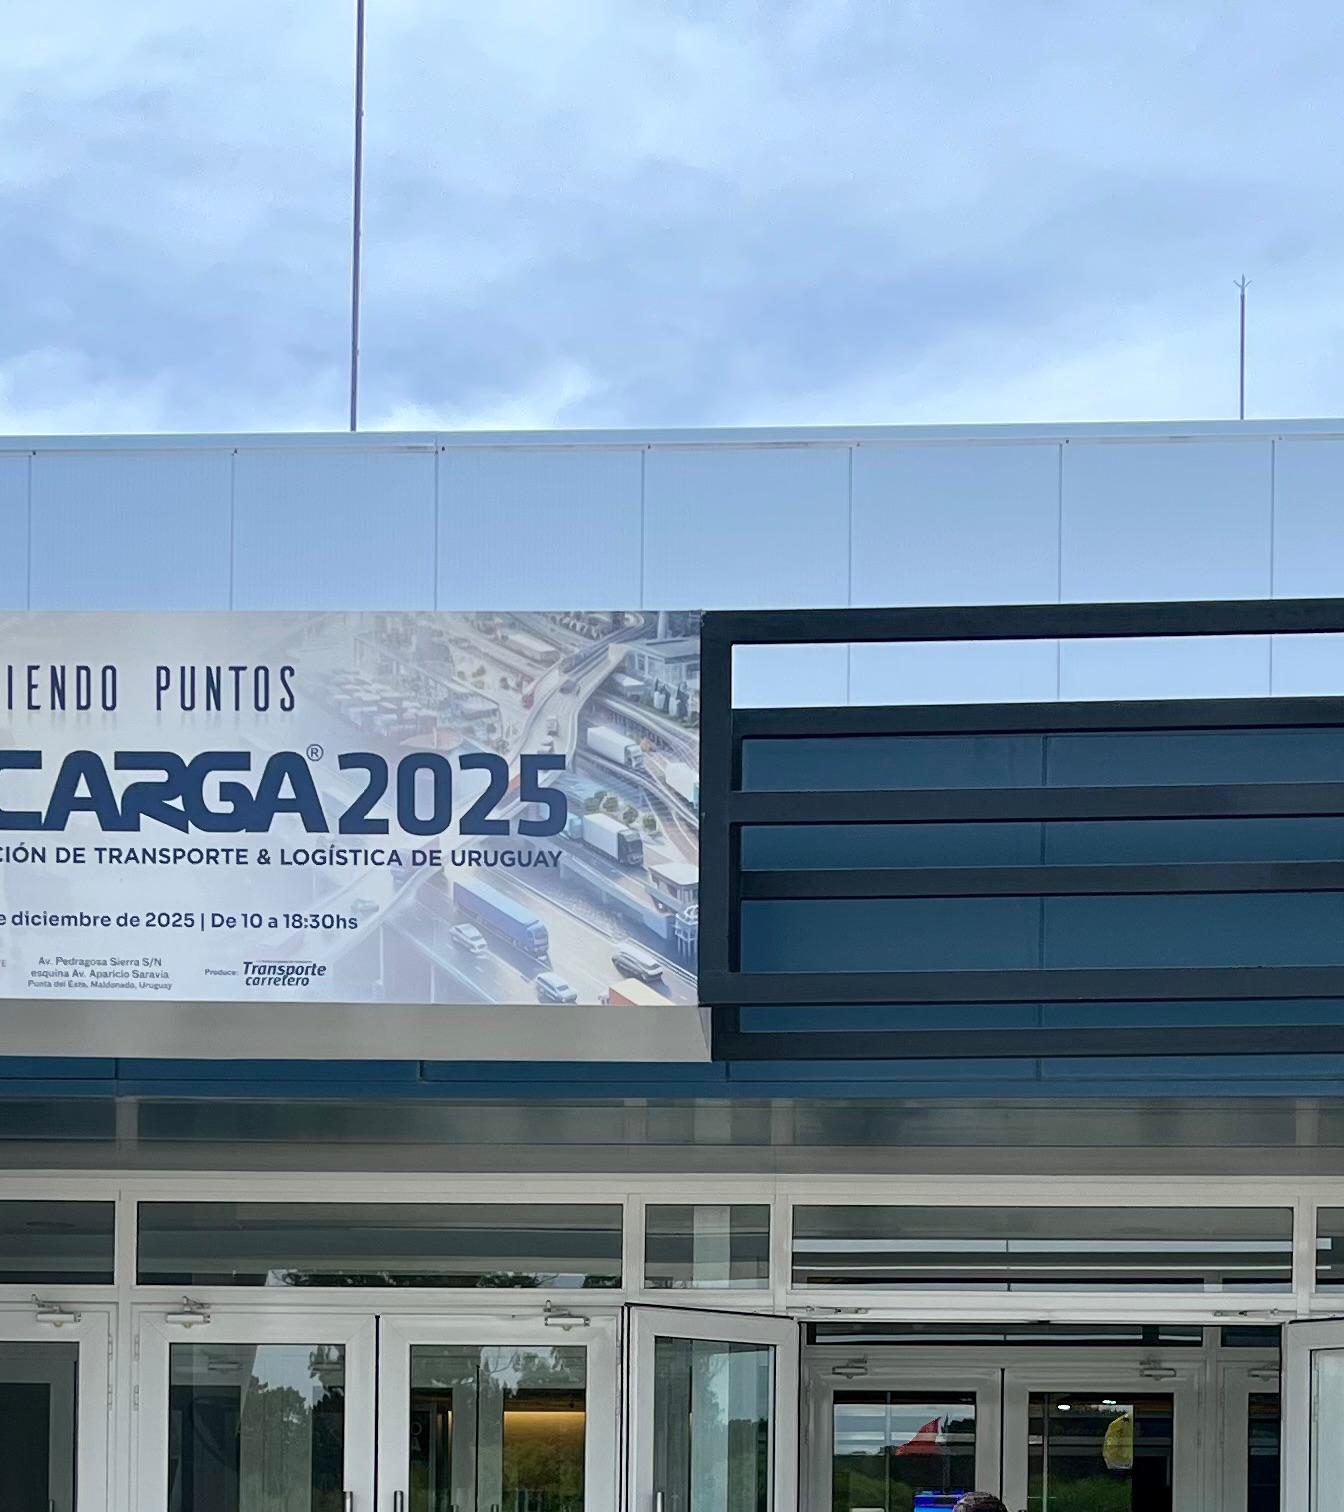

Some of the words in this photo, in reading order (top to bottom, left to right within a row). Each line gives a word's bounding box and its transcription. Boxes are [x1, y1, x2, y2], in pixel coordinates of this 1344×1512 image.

[155, 665, 296, 712] PUNTOS
[337, 751, 568, 837] 2025
[56, 846, 86, 864] DE
[94, 847, 249, 866] TRANSPORTE
[257, 848, 271, 866] &
[280, 844, 403, 867] LOGÍSTICA
[411, 849, 442, 867] DE
[451, 850, 563, 868] URUGUAY
[11, 910, 111, 927] diciembre
[116, 911, 140, 927] de
[145, 912, 195, 928] 2025
[211, 913, 236, 928] De
[241, 913, 263, 929] 10
[268, 917, 278, 928] a
[283, 913, 358, 929] 18:30hs
[109, 957, 140, 966] Sierra
[142, 957, 162, 967] S/N
[243, 961, 327, 979] Transporte
[30, 970, 70, 979] esquina
[89, 969, 130, 979] Aparicio
[132, 970, 169, 978] Saravia
[245, 975, 310, 986] carretero
